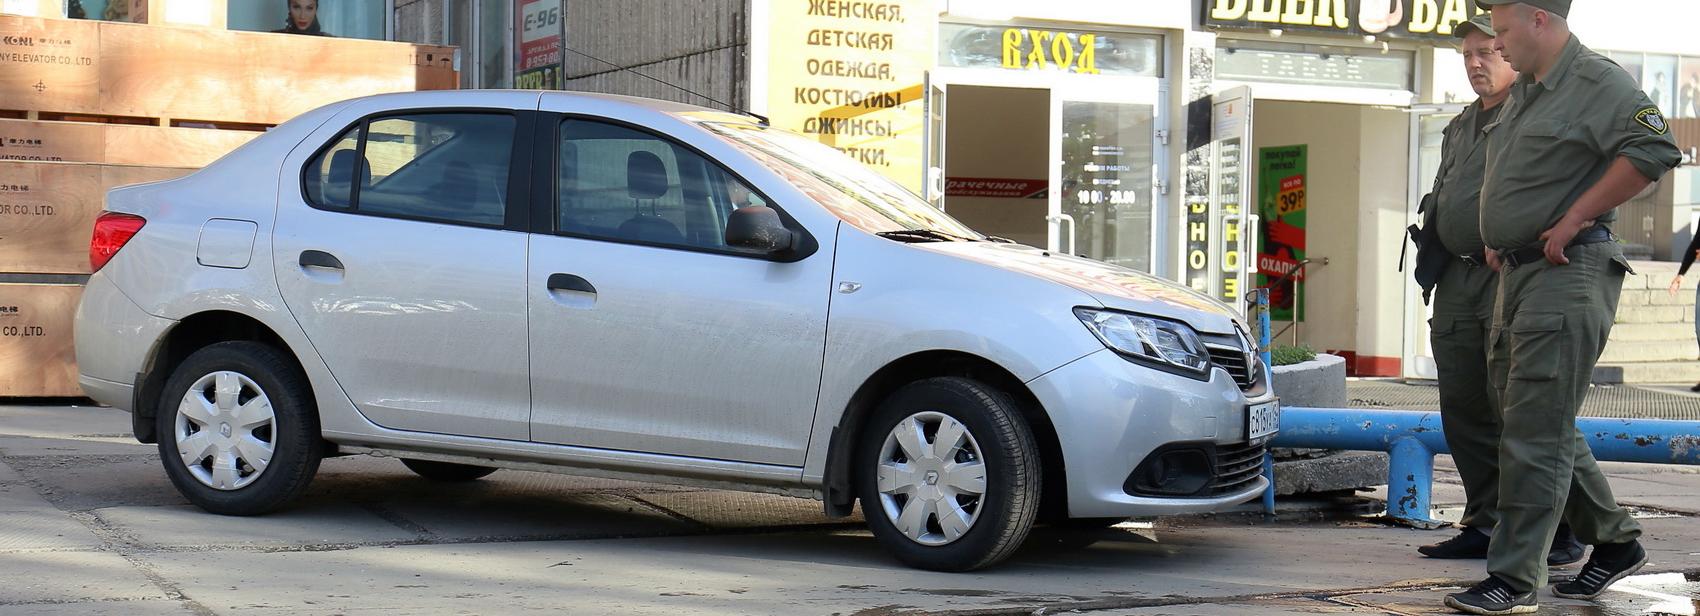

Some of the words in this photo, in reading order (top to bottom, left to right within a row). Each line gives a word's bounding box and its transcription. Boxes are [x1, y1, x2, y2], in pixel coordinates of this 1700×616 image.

[807, 29, 893, 51] ДЕТСКАЯ
[1001, 28, 1101, 75] ВХОД
[806, 58, 895, 82] ОДЕЖДА,
[803, 117, 897, 139] ДЖИНСЫ,
